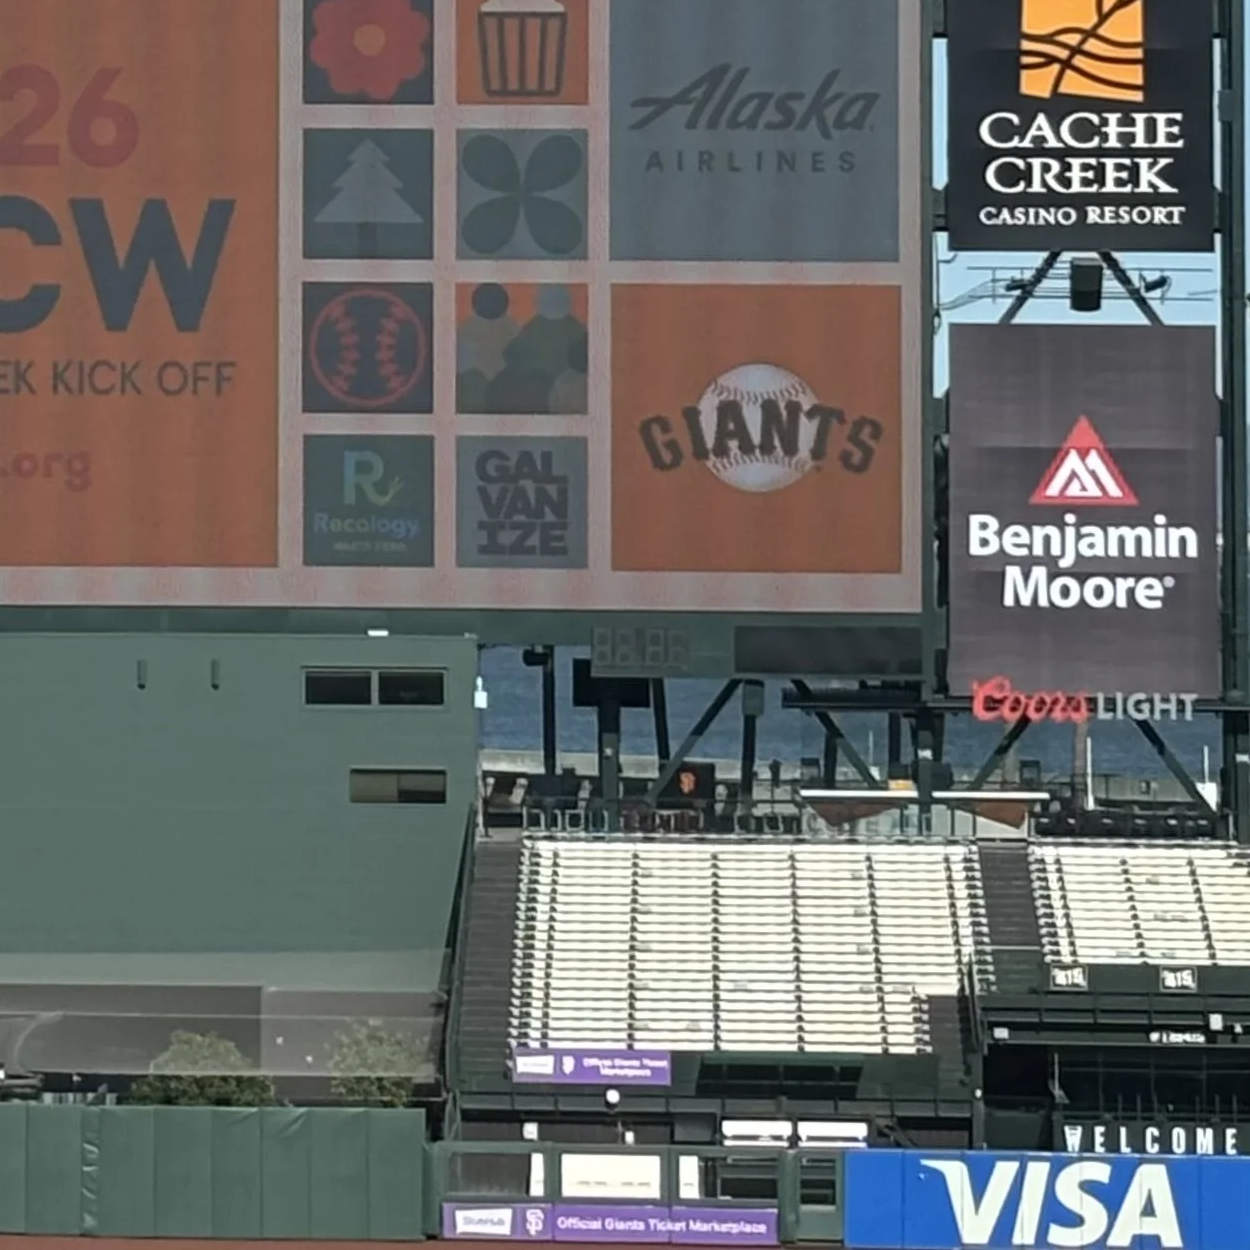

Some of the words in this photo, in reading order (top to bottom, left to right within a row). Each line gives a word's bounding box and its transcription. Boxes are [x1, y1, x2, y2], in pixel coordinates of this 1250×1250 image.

[629, 63, 881, 140] Alaska
[978, 112, 1184, 150] CACHE
[645, 150, 856, 173] AIRLINES
[984, 157, 1178, 194] CREEK
[979, 206, 1077, 226] CASINO
[1086, 206, 1184, 225] RESORT
[51, 358, 143, 396] KICK
[157, 359, 237, 396] OFF
[638, 399, 884, 475] GIANTS
[344, 450, 398, 506] R
[475, 450, 568, 485] GAL
[476, 485, 568, 520] VAN
[314, 512, 420, 538] Recology
[477, 521, 568, 556] IZE
[968, 514, 1197, 568] Benjamin
[971, 675, 1088, 724] Coors
[1097, 691, 1198, 721] LIGHT
[1064, 1125, 1237, 1155] WELCOME
[920, 1160, 1183, 1248] VISA
[557, 1217, 602, 1231] Official
[605, 1217, 645, 1232] Giants
[649, 1218, 686, 1232] Ticket
[689, 1218, 768, 1234] Marketplace
